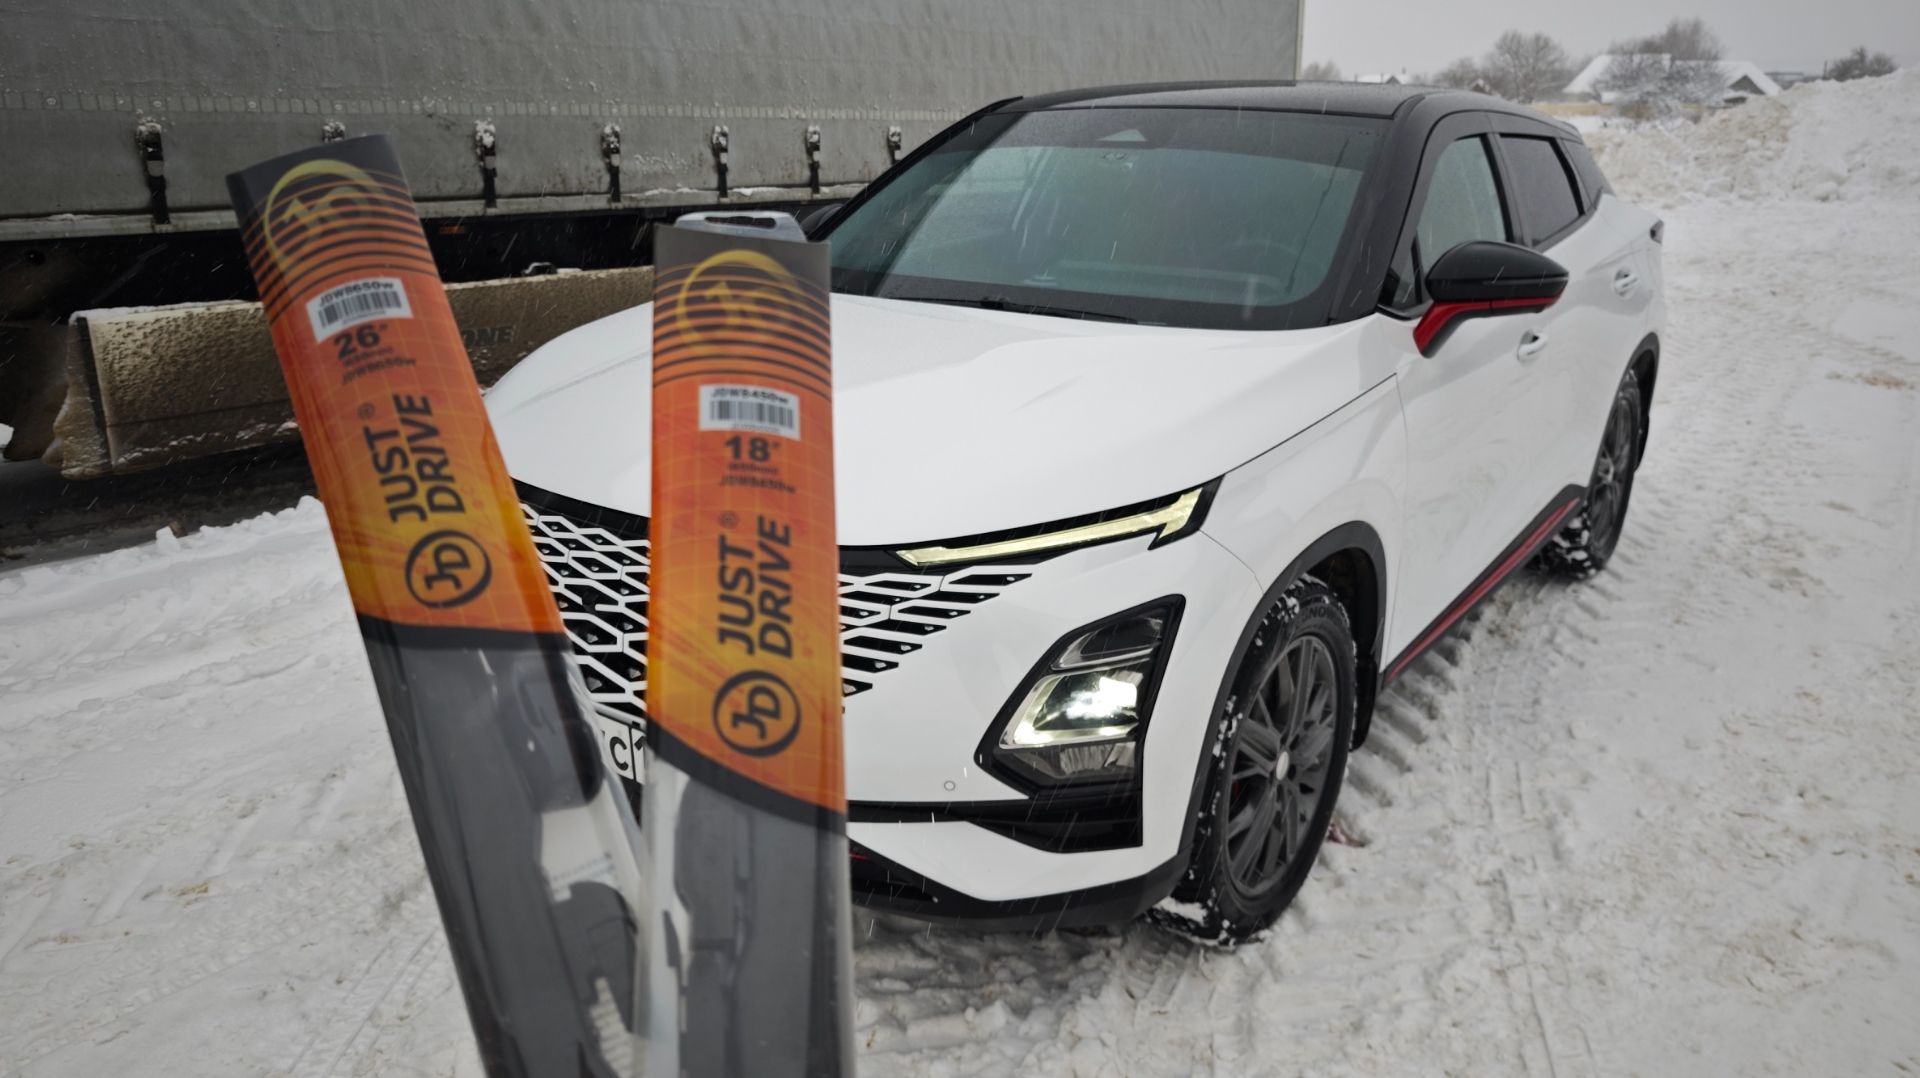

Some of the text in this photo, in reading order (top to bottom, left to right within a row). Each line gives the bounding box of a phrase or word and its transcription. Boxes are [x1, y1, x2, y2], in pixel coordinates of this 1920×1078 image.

[461, 325, 513, 346] ONE
[362, 425, 429, 524] JUST
[392, 393, 466, 515] DRIVE
[424, 542, 472, 591] JD
[718, 535, 755, 656] JUST
[757, 515, 794, 659] DRIVE
[731, 685, 783, 740] JD
